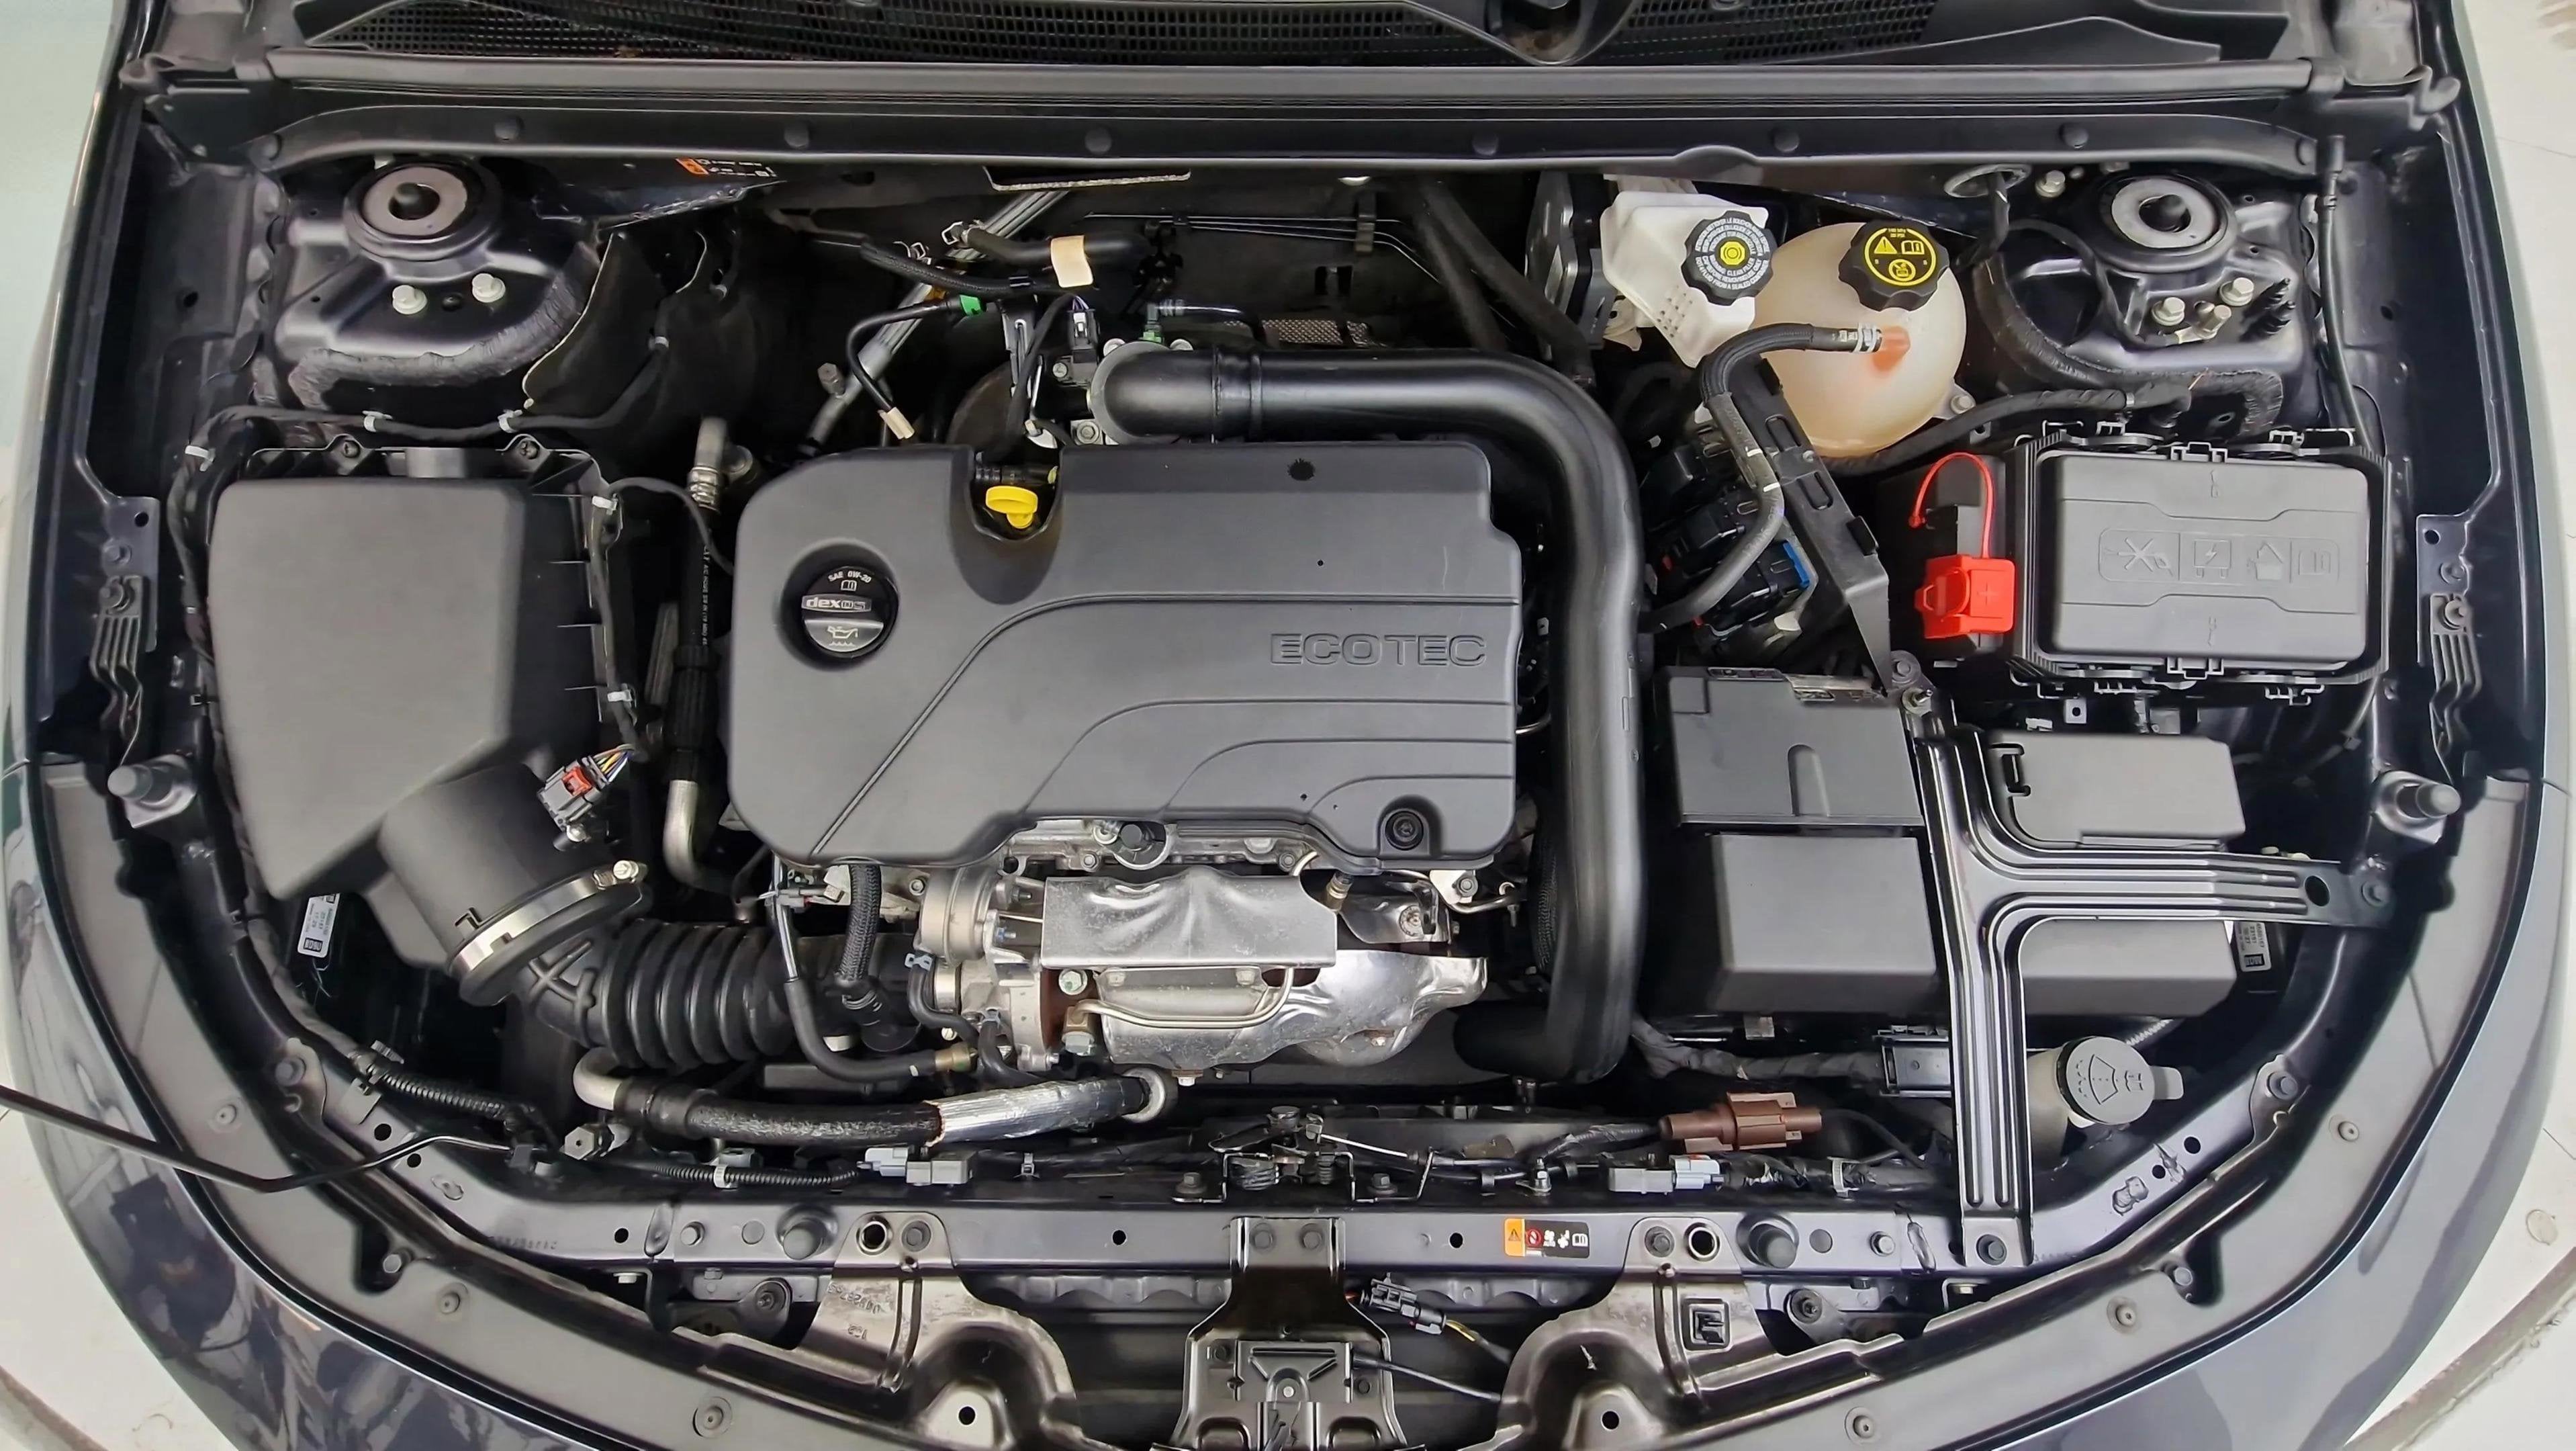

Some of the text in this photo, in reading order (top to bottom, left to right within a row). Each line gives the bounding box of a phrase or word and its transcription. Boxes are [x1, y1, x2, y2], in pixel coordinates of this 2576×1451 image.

[828, 570, 872, 583] SAE 0W-20
[806, 597, 866, 610] dexos
[1271, 633, 1486, 666] ECOTEC
